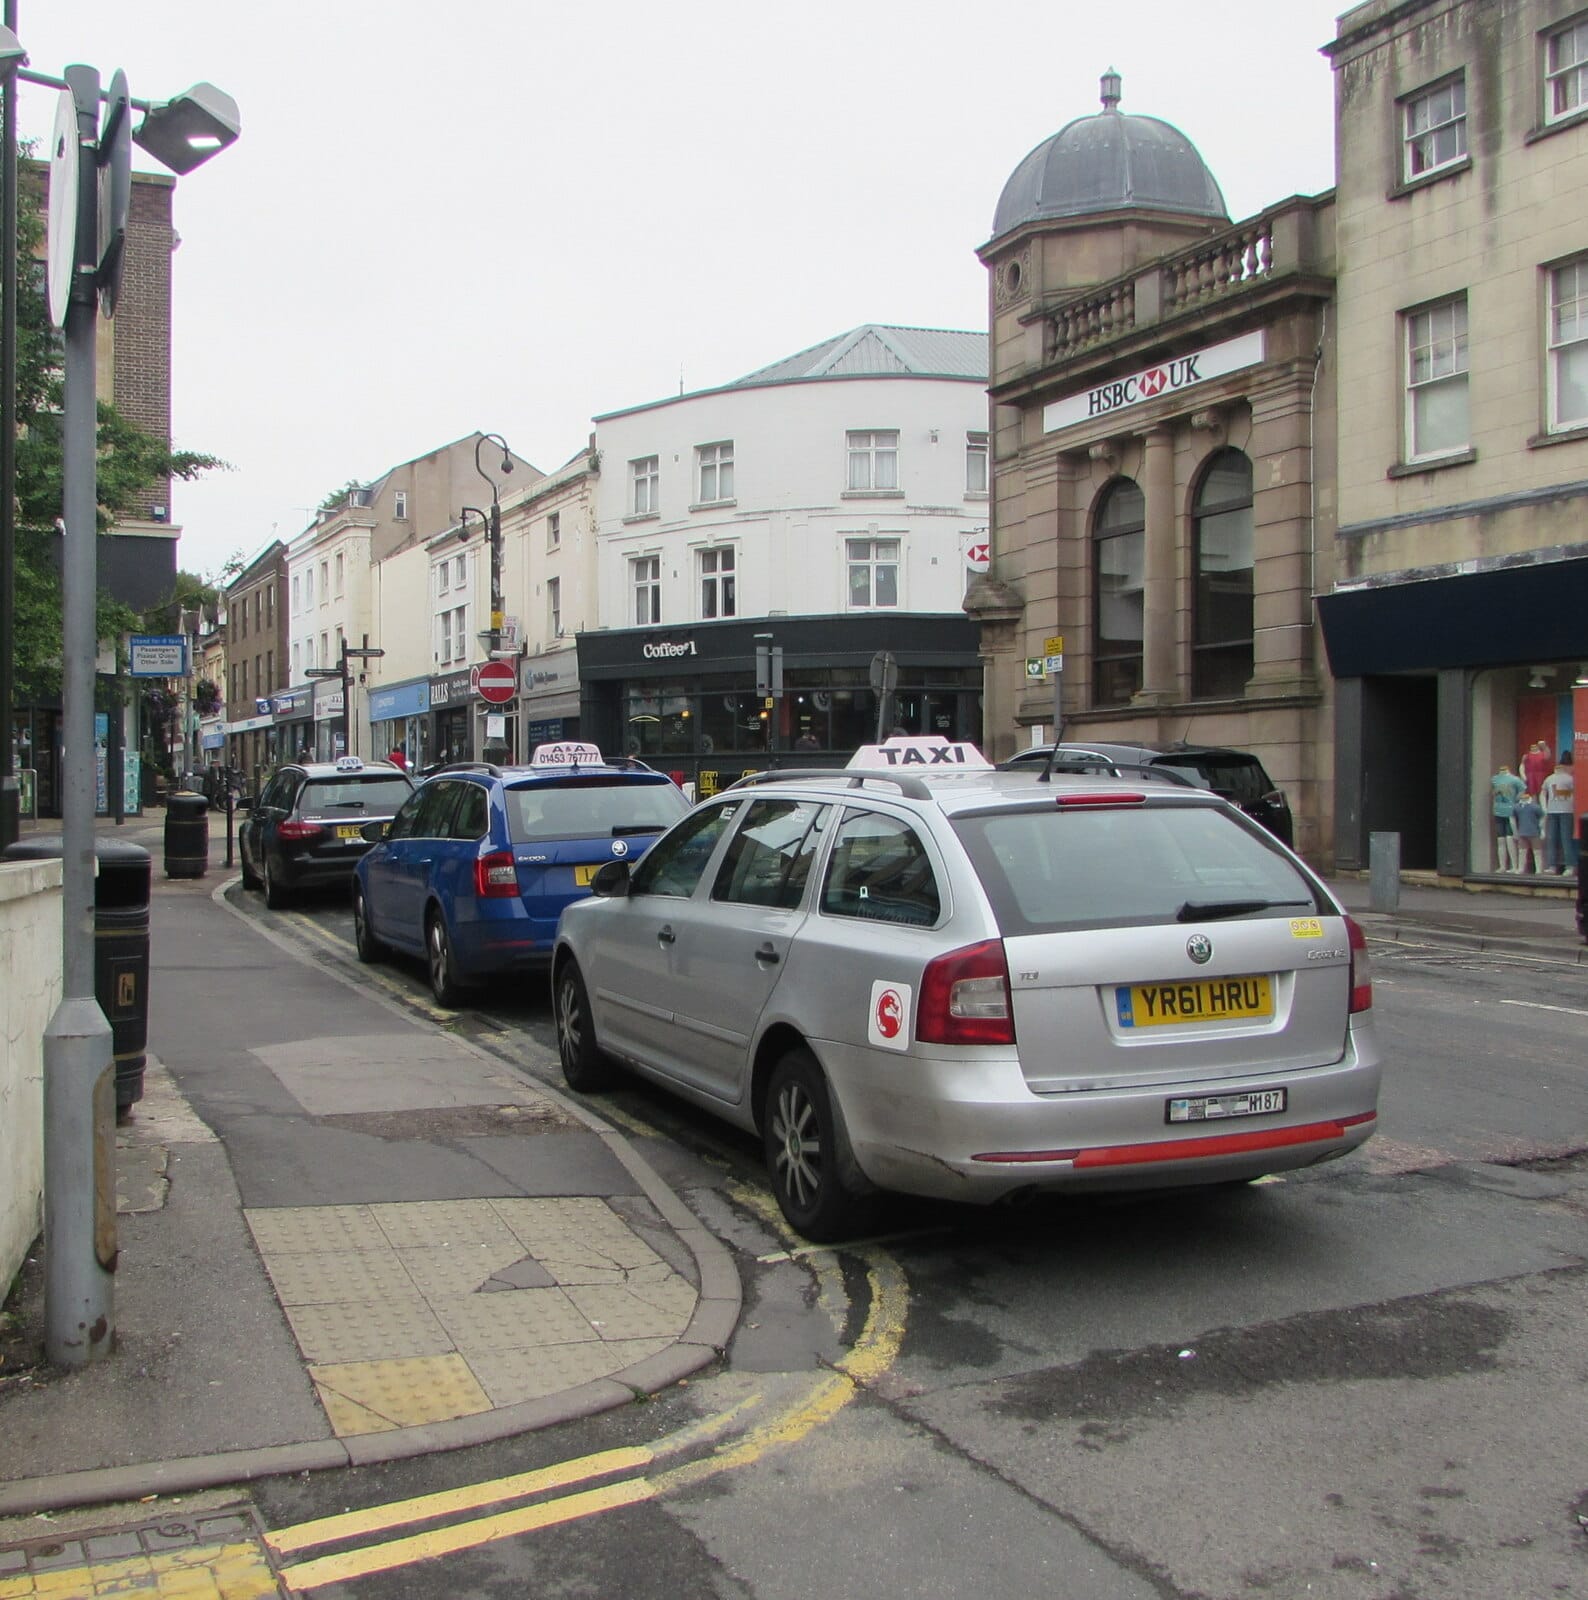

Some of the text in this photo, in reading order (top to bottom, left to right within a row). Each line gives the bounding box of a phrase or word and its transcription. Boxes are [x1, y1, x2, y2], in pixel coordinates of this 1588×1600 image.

[1088, 354, 1202, 416] HSBC UK
[553, 745, 563, 753] A
[878, 746, 966, 765] TAXI
[540, 752, 599, 763] 01453 767777
[340, 826, 361, 836] FV6
[1141, 980, 1260, 1017] YR61 HRU
